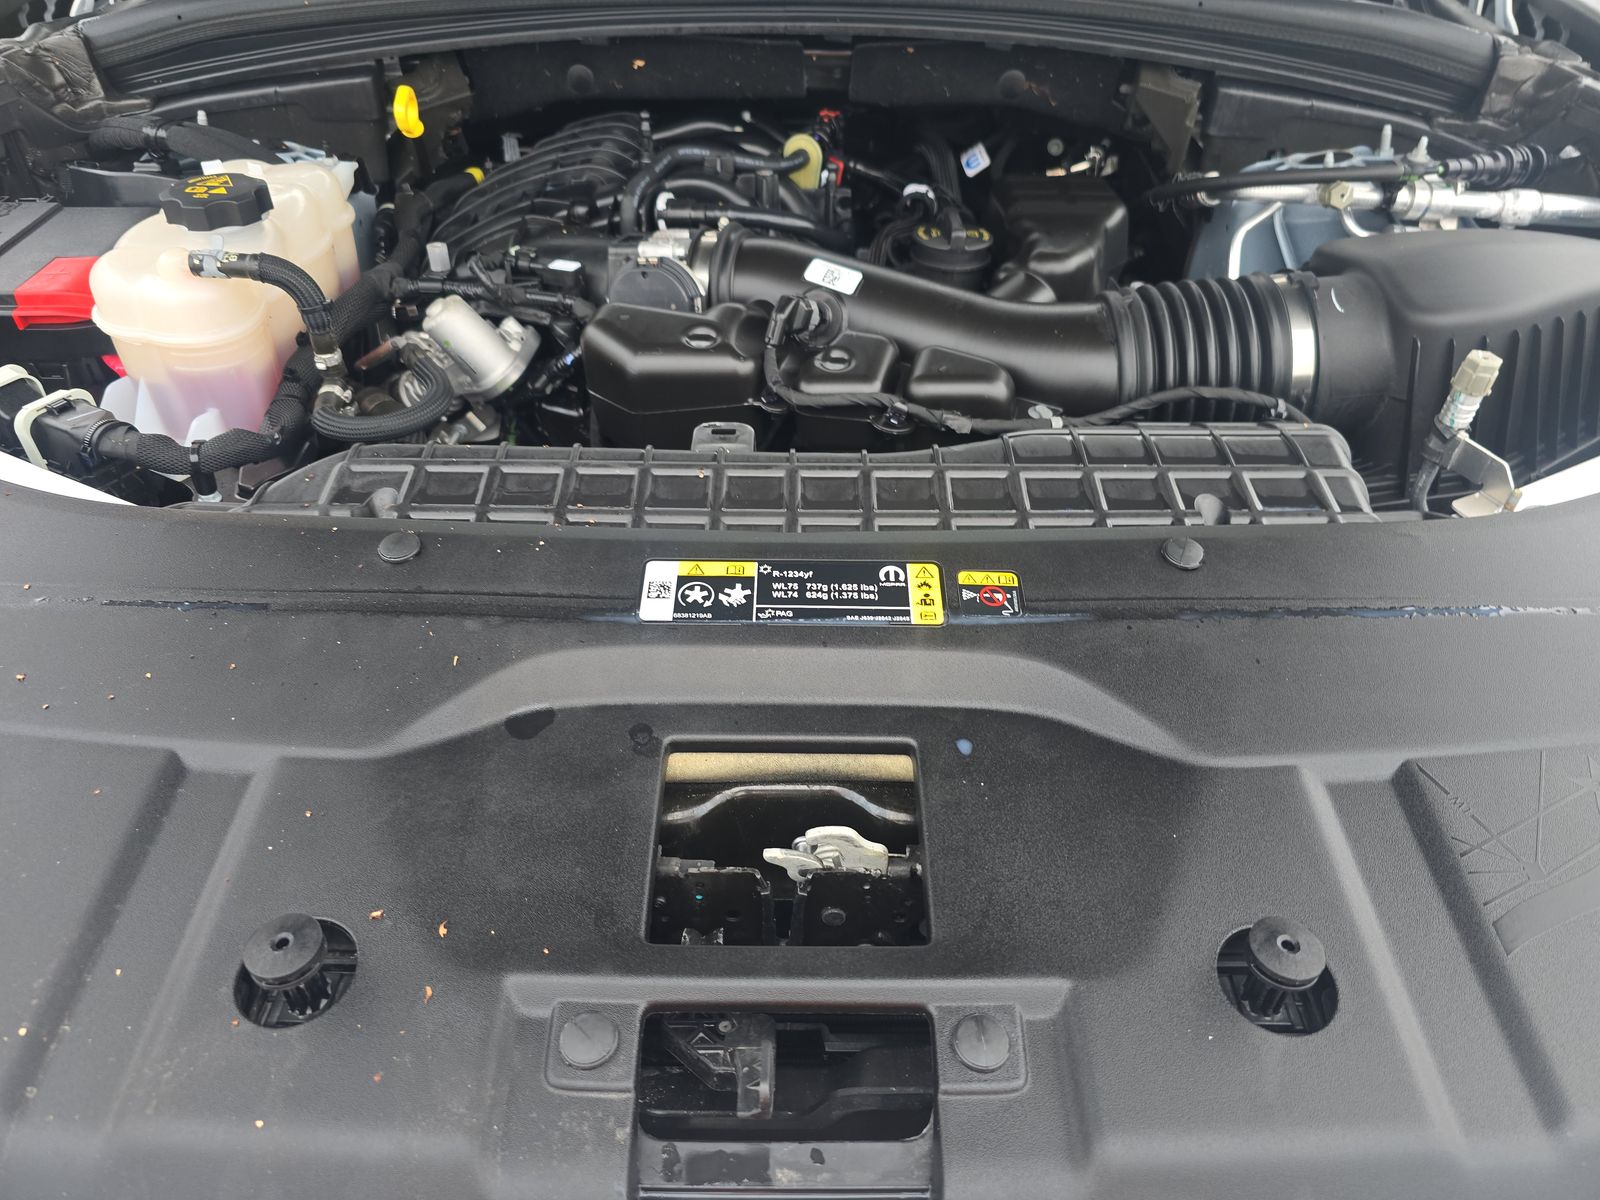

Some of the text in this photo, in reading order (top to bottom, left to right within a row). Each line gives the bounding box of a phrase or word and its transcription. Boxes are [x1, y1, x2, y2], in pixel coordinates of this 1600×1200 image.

[772, 570, 813, 579] R-1234yf
[805, 583, 828, 592] 737g
[830, 583, 859, 592] (1.625
[860, 583, 878, 592] lbs)
[772, 591, 879, 601] WL74 624g (1.375 lbs)
